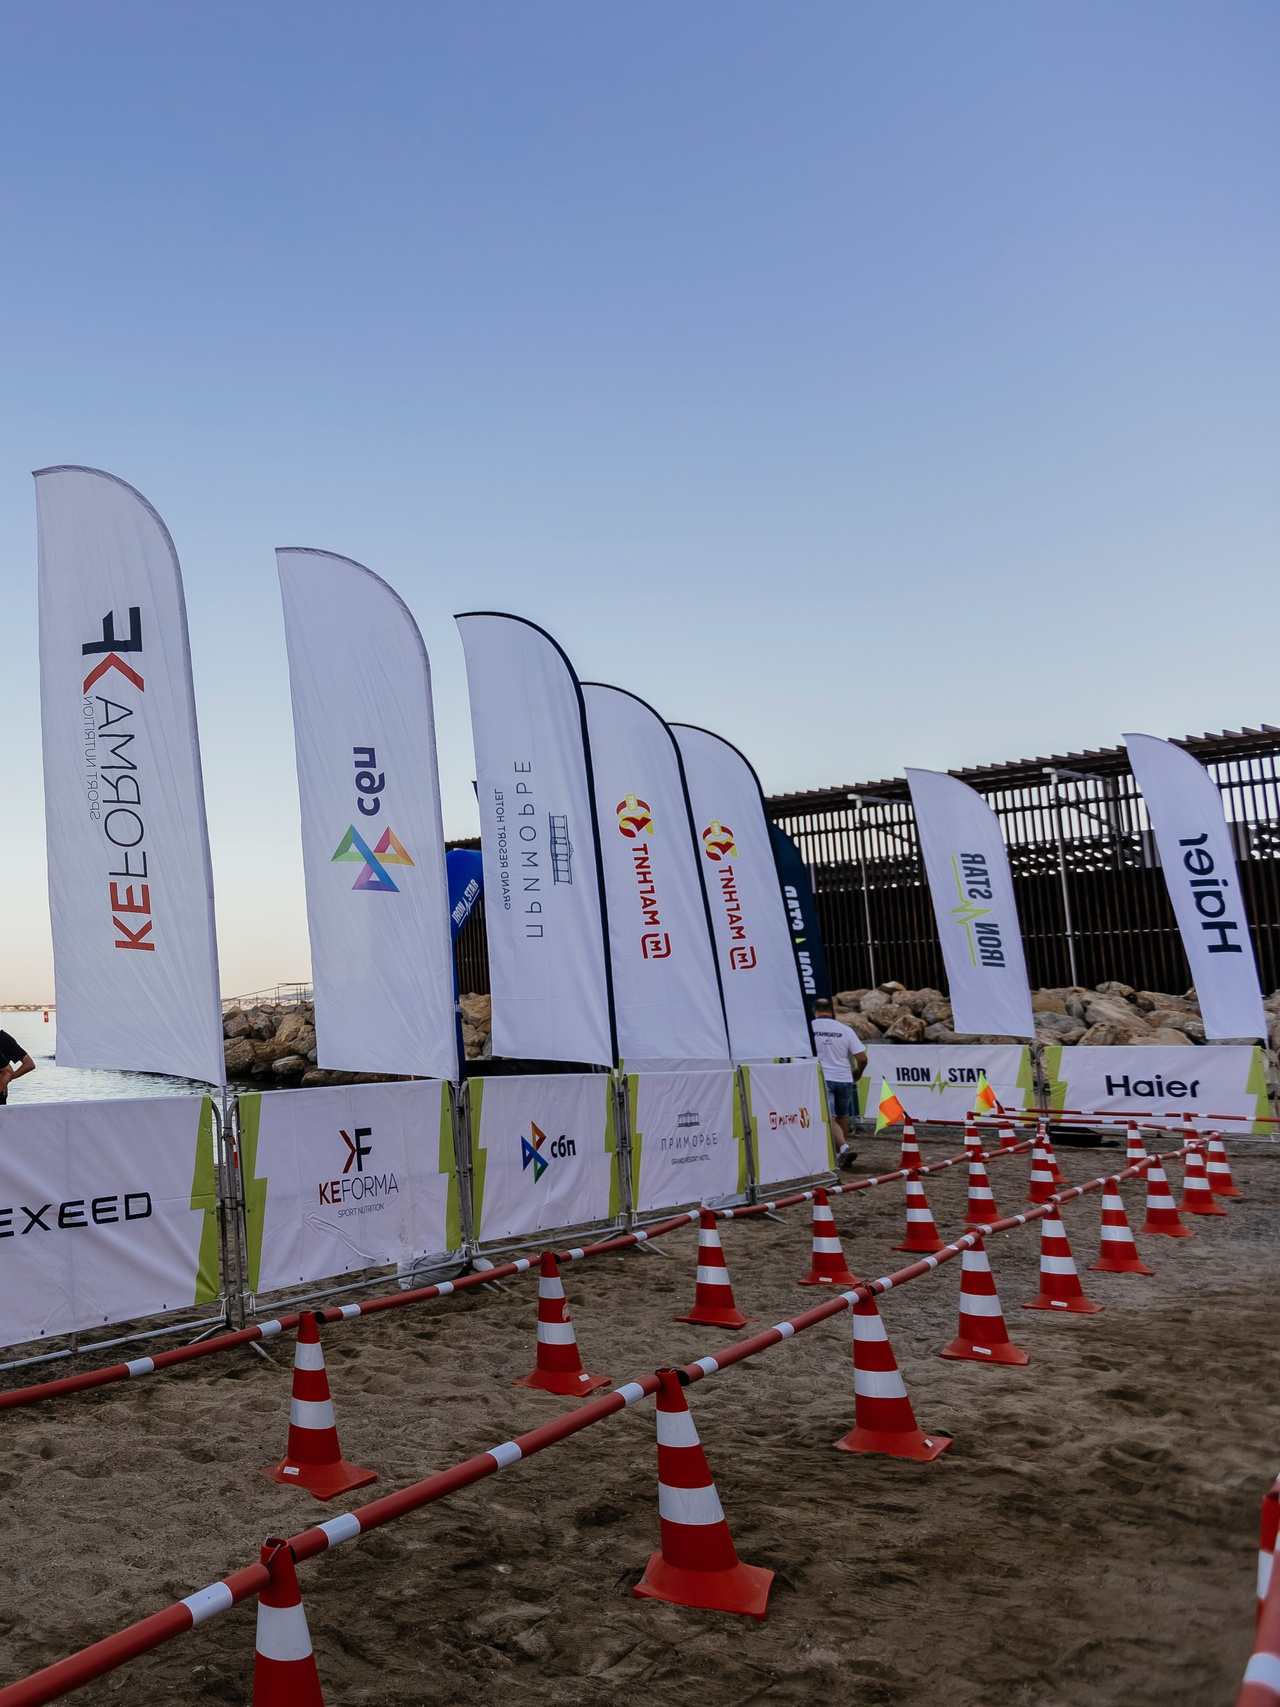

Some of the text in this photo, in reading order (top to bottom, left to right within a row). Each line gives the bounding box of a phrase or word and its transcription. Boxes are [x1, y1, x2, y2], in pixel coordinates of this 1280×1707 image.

[451, 878, 479, 924] IRON STAR
[896, 1067, 931, 1082] IRON
[1104, 1074, 1200, 1098] Haier
[661, 1133, 718, 1151] ПРИМОРЬЕ
[319, 1173, 399, 1206] KEFORMA
[337, 1203, 384, 1218] SPORT NUTRITION
